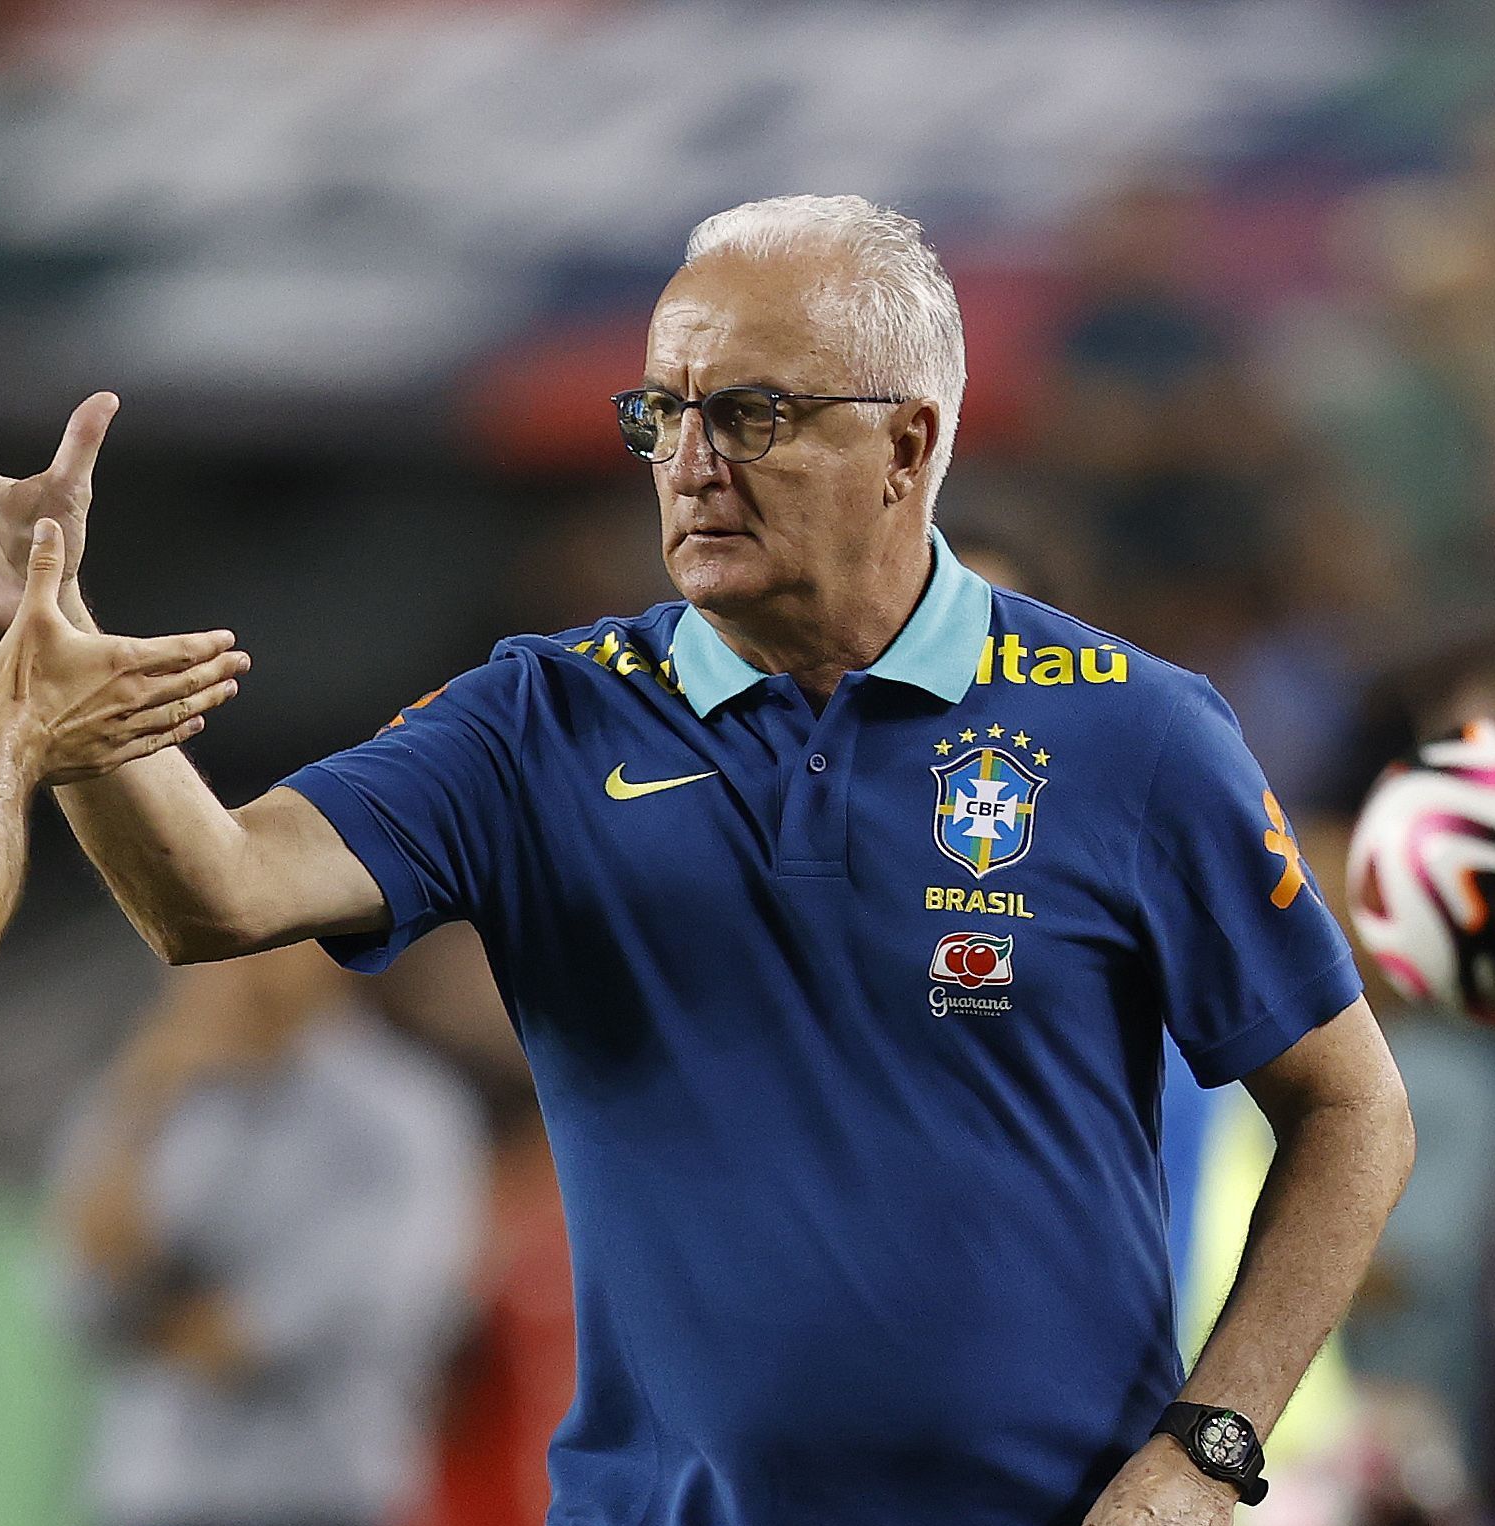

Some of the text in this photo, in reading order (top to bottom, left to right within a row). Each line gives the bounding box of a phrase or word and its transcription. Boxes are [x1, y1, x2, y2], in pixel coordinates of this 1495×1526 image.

[965, 800, 1006, 818] CBF
[925, 886, 1035, 919] BRASIL
[928, 986, 1013, 1018] Guaraná
